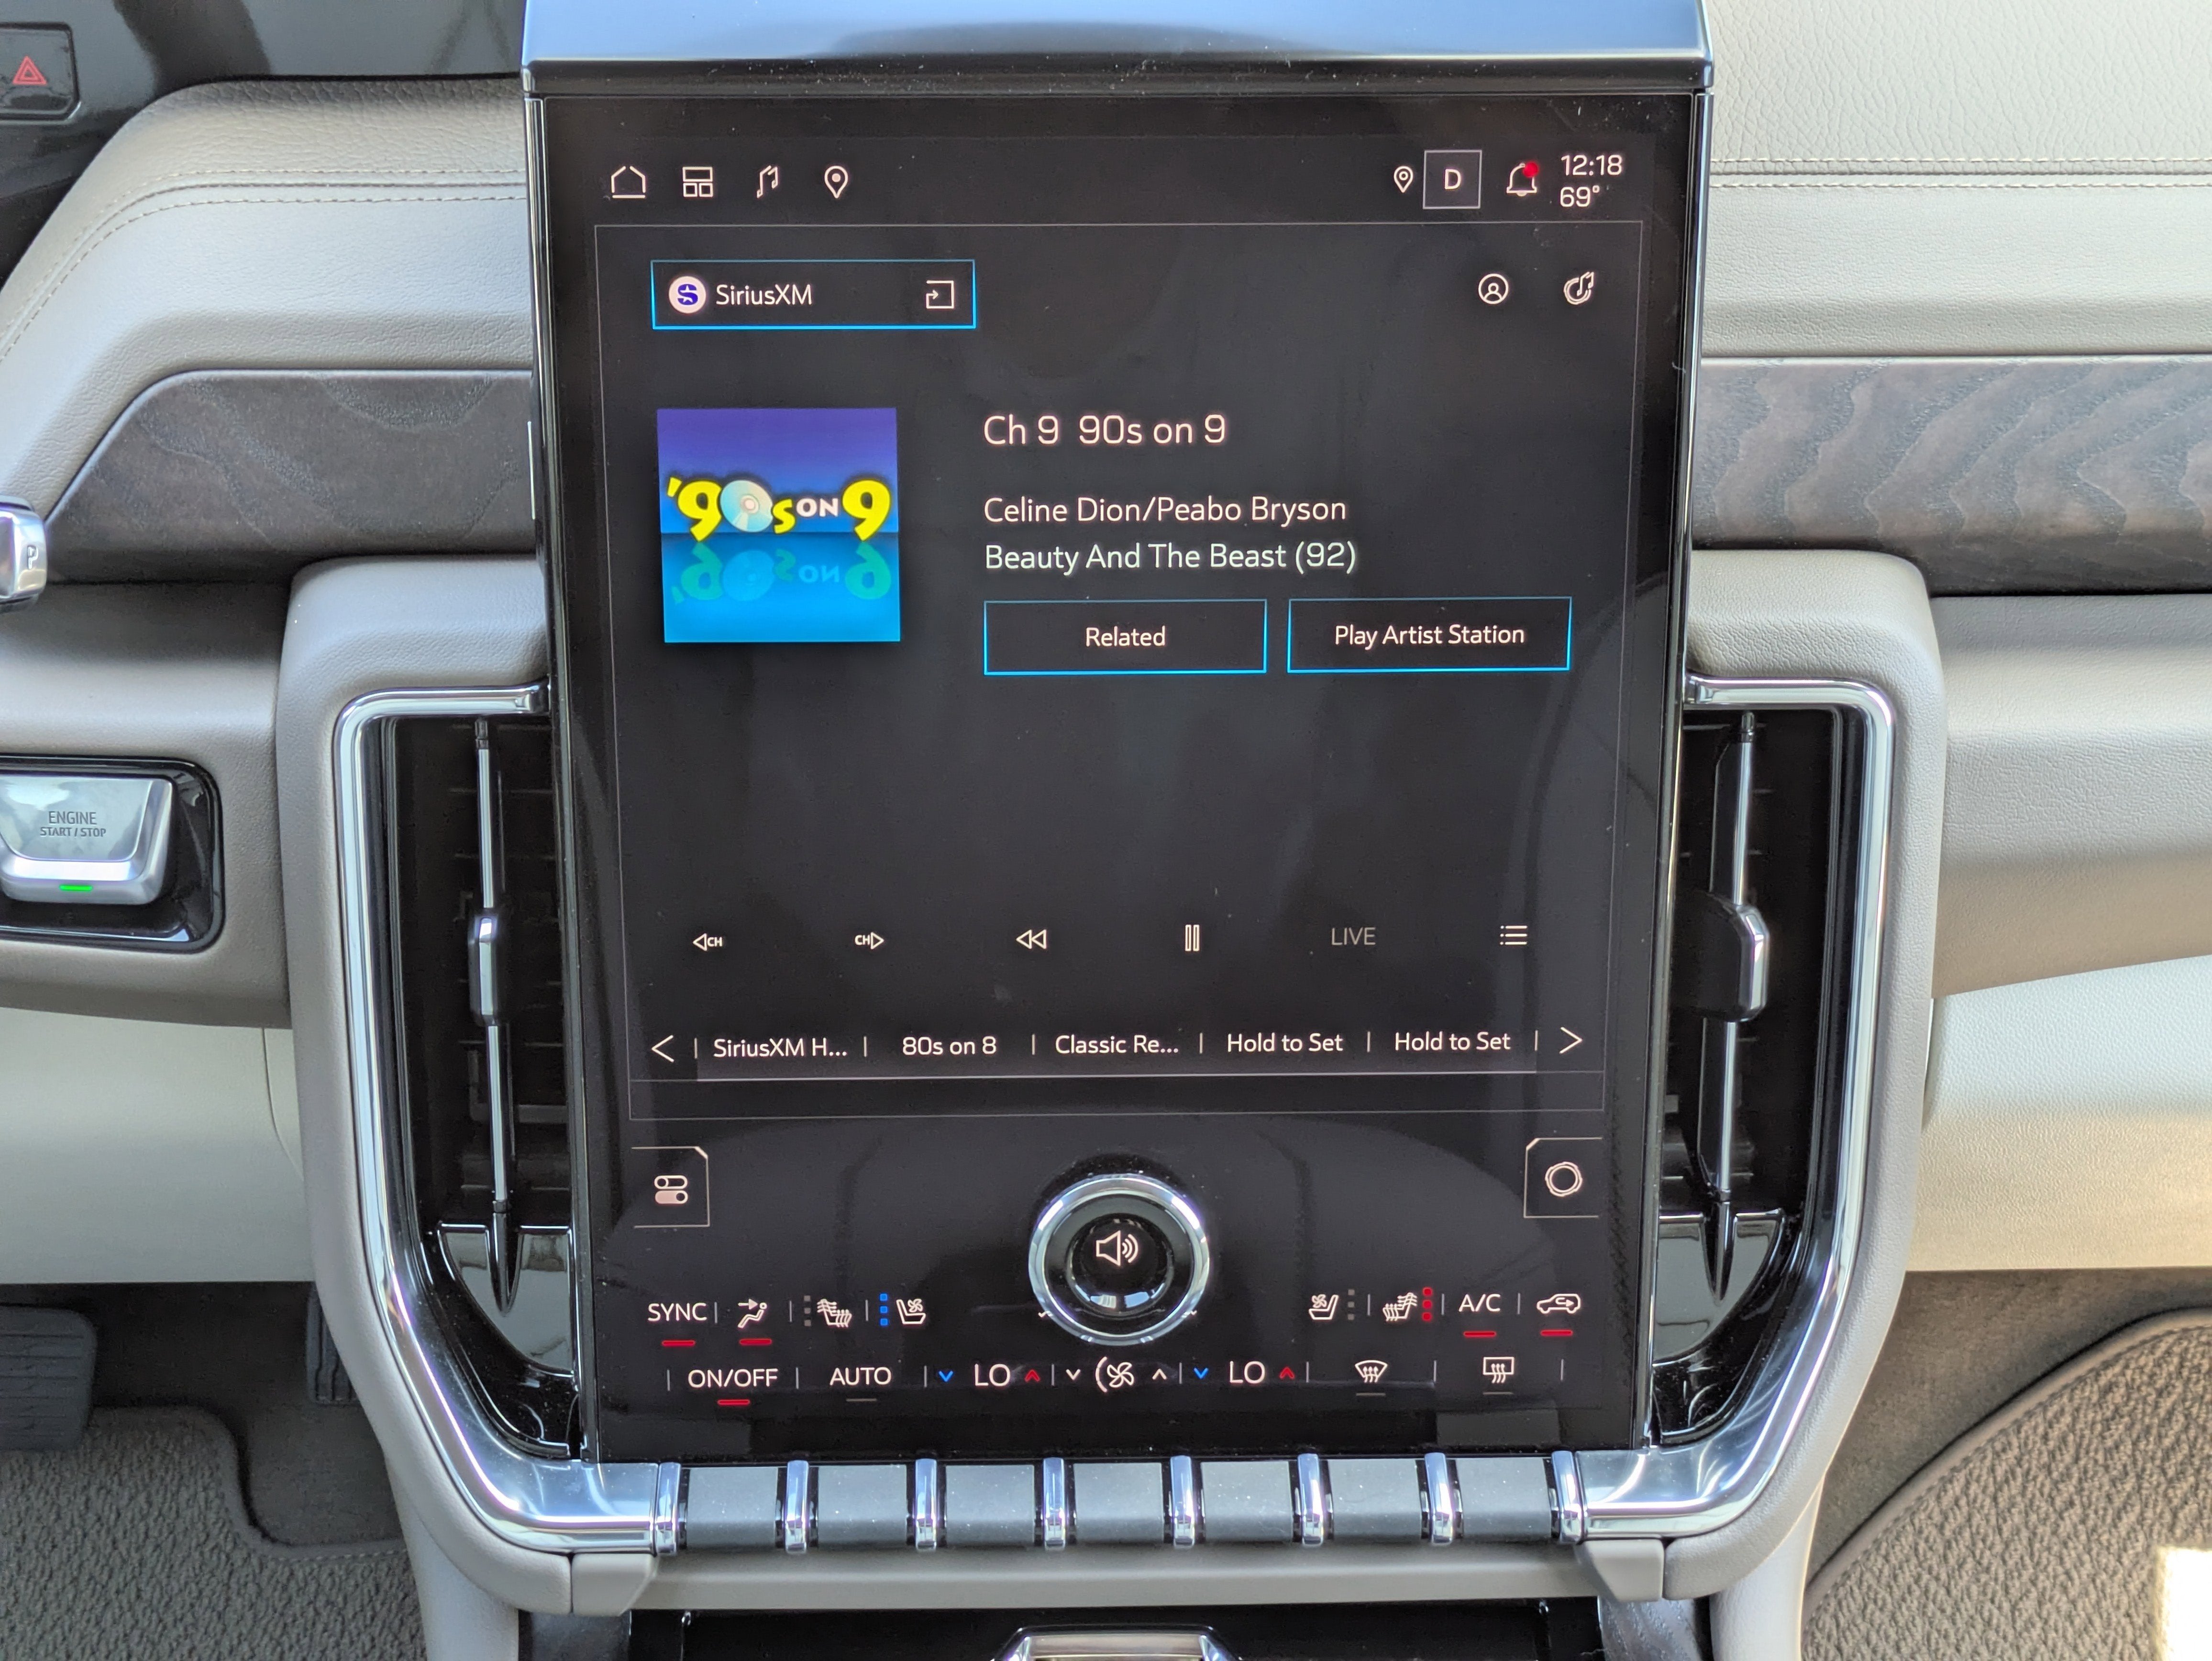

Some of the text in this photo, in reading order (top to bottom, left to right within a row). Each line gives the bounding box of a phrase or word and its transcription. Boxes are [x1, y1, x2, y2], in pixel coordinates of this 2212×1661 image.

[1560, 154, 1623, 177] 12:18
[1444, 168, 1462, 190] D
[1559, 185, 1601, 208] 69°
[716, 283, 813, 306] SiriusXM
[984, 413, 1226, 445] Ch 9 90s on 9
[796, 498, 839, 517] ON
[842, 480, 891, 541] 9
[984, 495, 1346, 528] Celine Dion/Peabo Bryson
[27, 544, 39, 569] P
[985, 540, 1356, 576] Beauty And The Beast (92)
[1085, 625, 1166, 647] Related
[1335, 623, 1525, 651] Play Artist Station
[48, 811, 97, 825] ENGINE
[707, 936, 723, 947] CH
[854, 934, 870, 945] CH
[1331, 927, 1376, 946] LIVE
[713, 1038, 805, 1058] SiriusXM
[902, 1035, 997, 1056] 80s on 8
[1055, 1034, 1126, 1054] Classic
[1227, 1032, 1344, 1053] Hold to Set
[1394, 1030, 1511, 1052] Hold to Set
[647, 1302, 708, 1322] SYNC
[1458, 1293, 1501, 1313] A/C
[687, 1368, 779, 1389] ON/OFF
[829, 1366, 892, 1386] AUTO
[974, 1363, 1011, 1387] LO
[1229, 1360, 1266, 1384] LO
